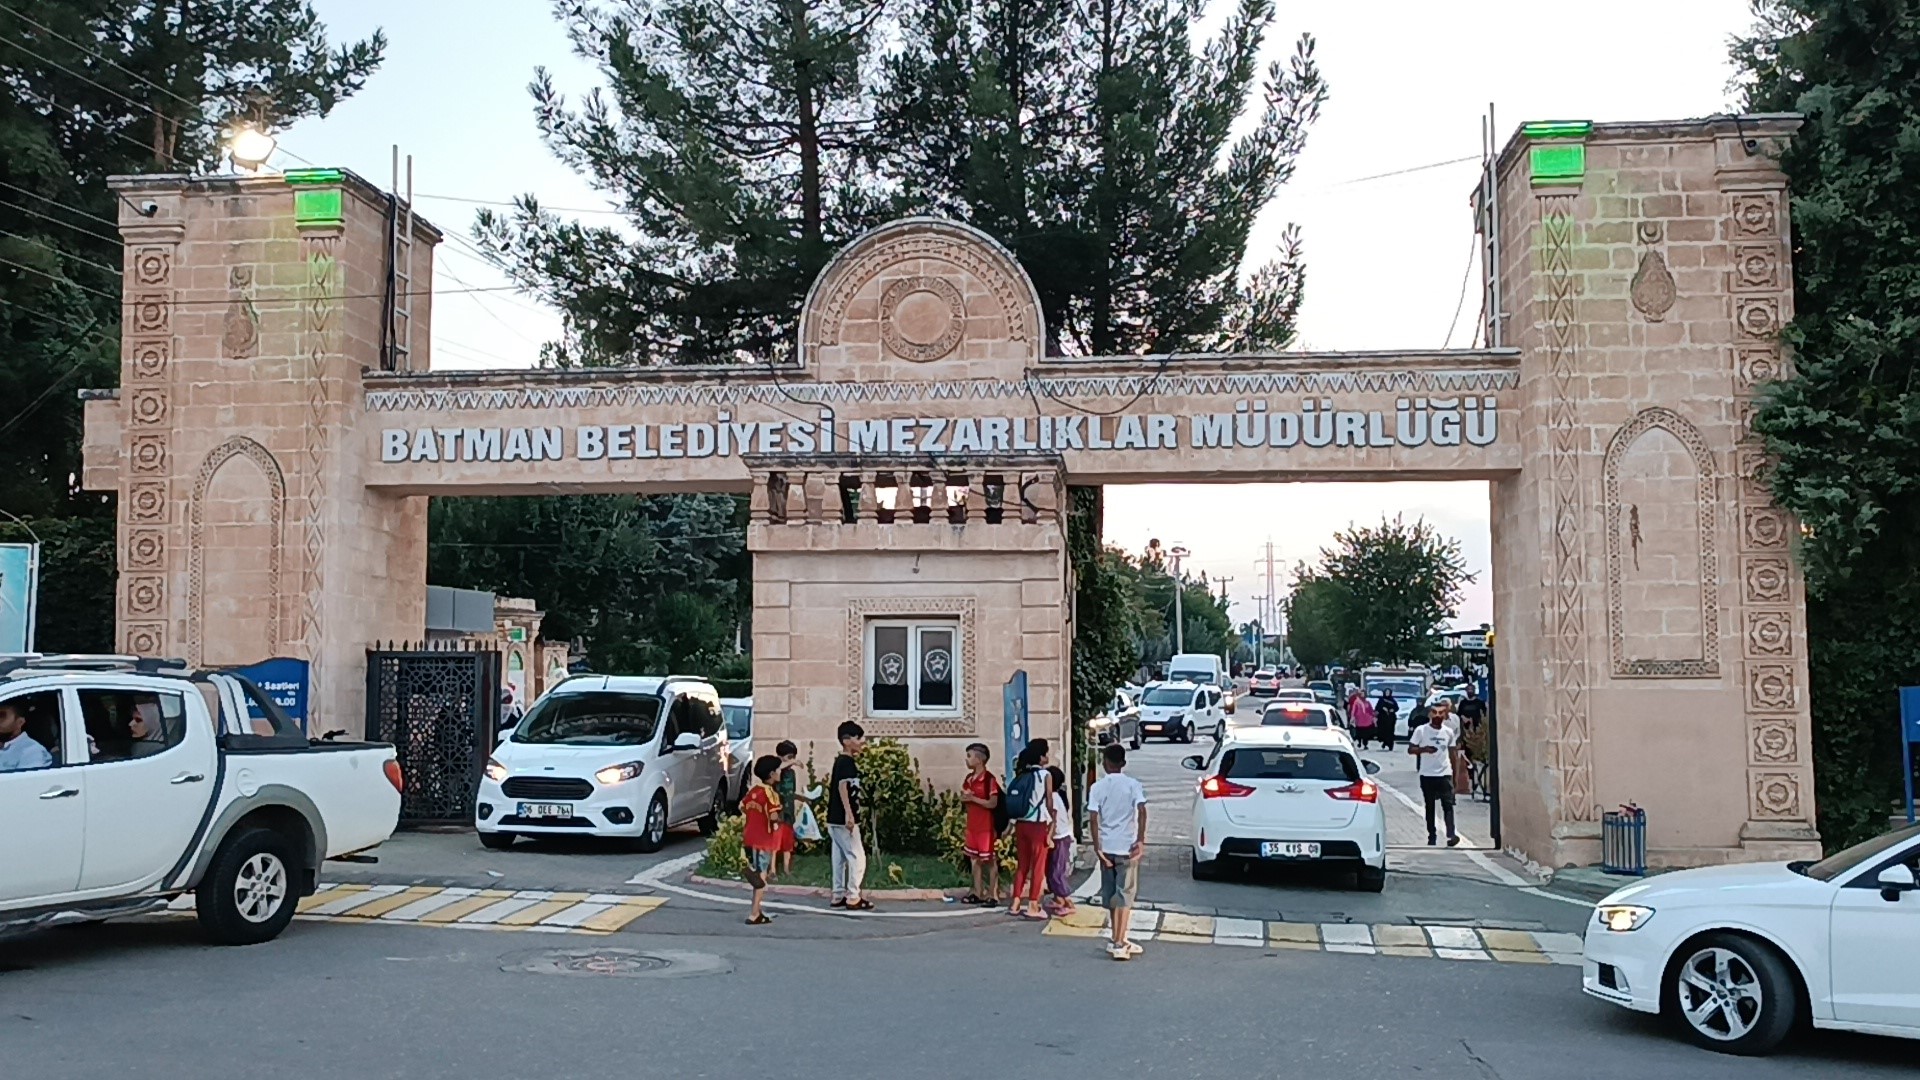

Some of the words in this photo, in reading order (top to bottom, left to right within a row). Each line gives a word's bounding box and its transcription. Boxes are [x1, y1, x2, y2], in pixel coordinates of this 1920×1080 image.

[381, 426, 563, 463] BATMAN
[576, 411, 833, 460] BELEDİYESİ
[848, 412, 1178, 456] MEZARLIKLAR
[1190, 396, 1499, 450] MÜDÜRLÜĞÜ
